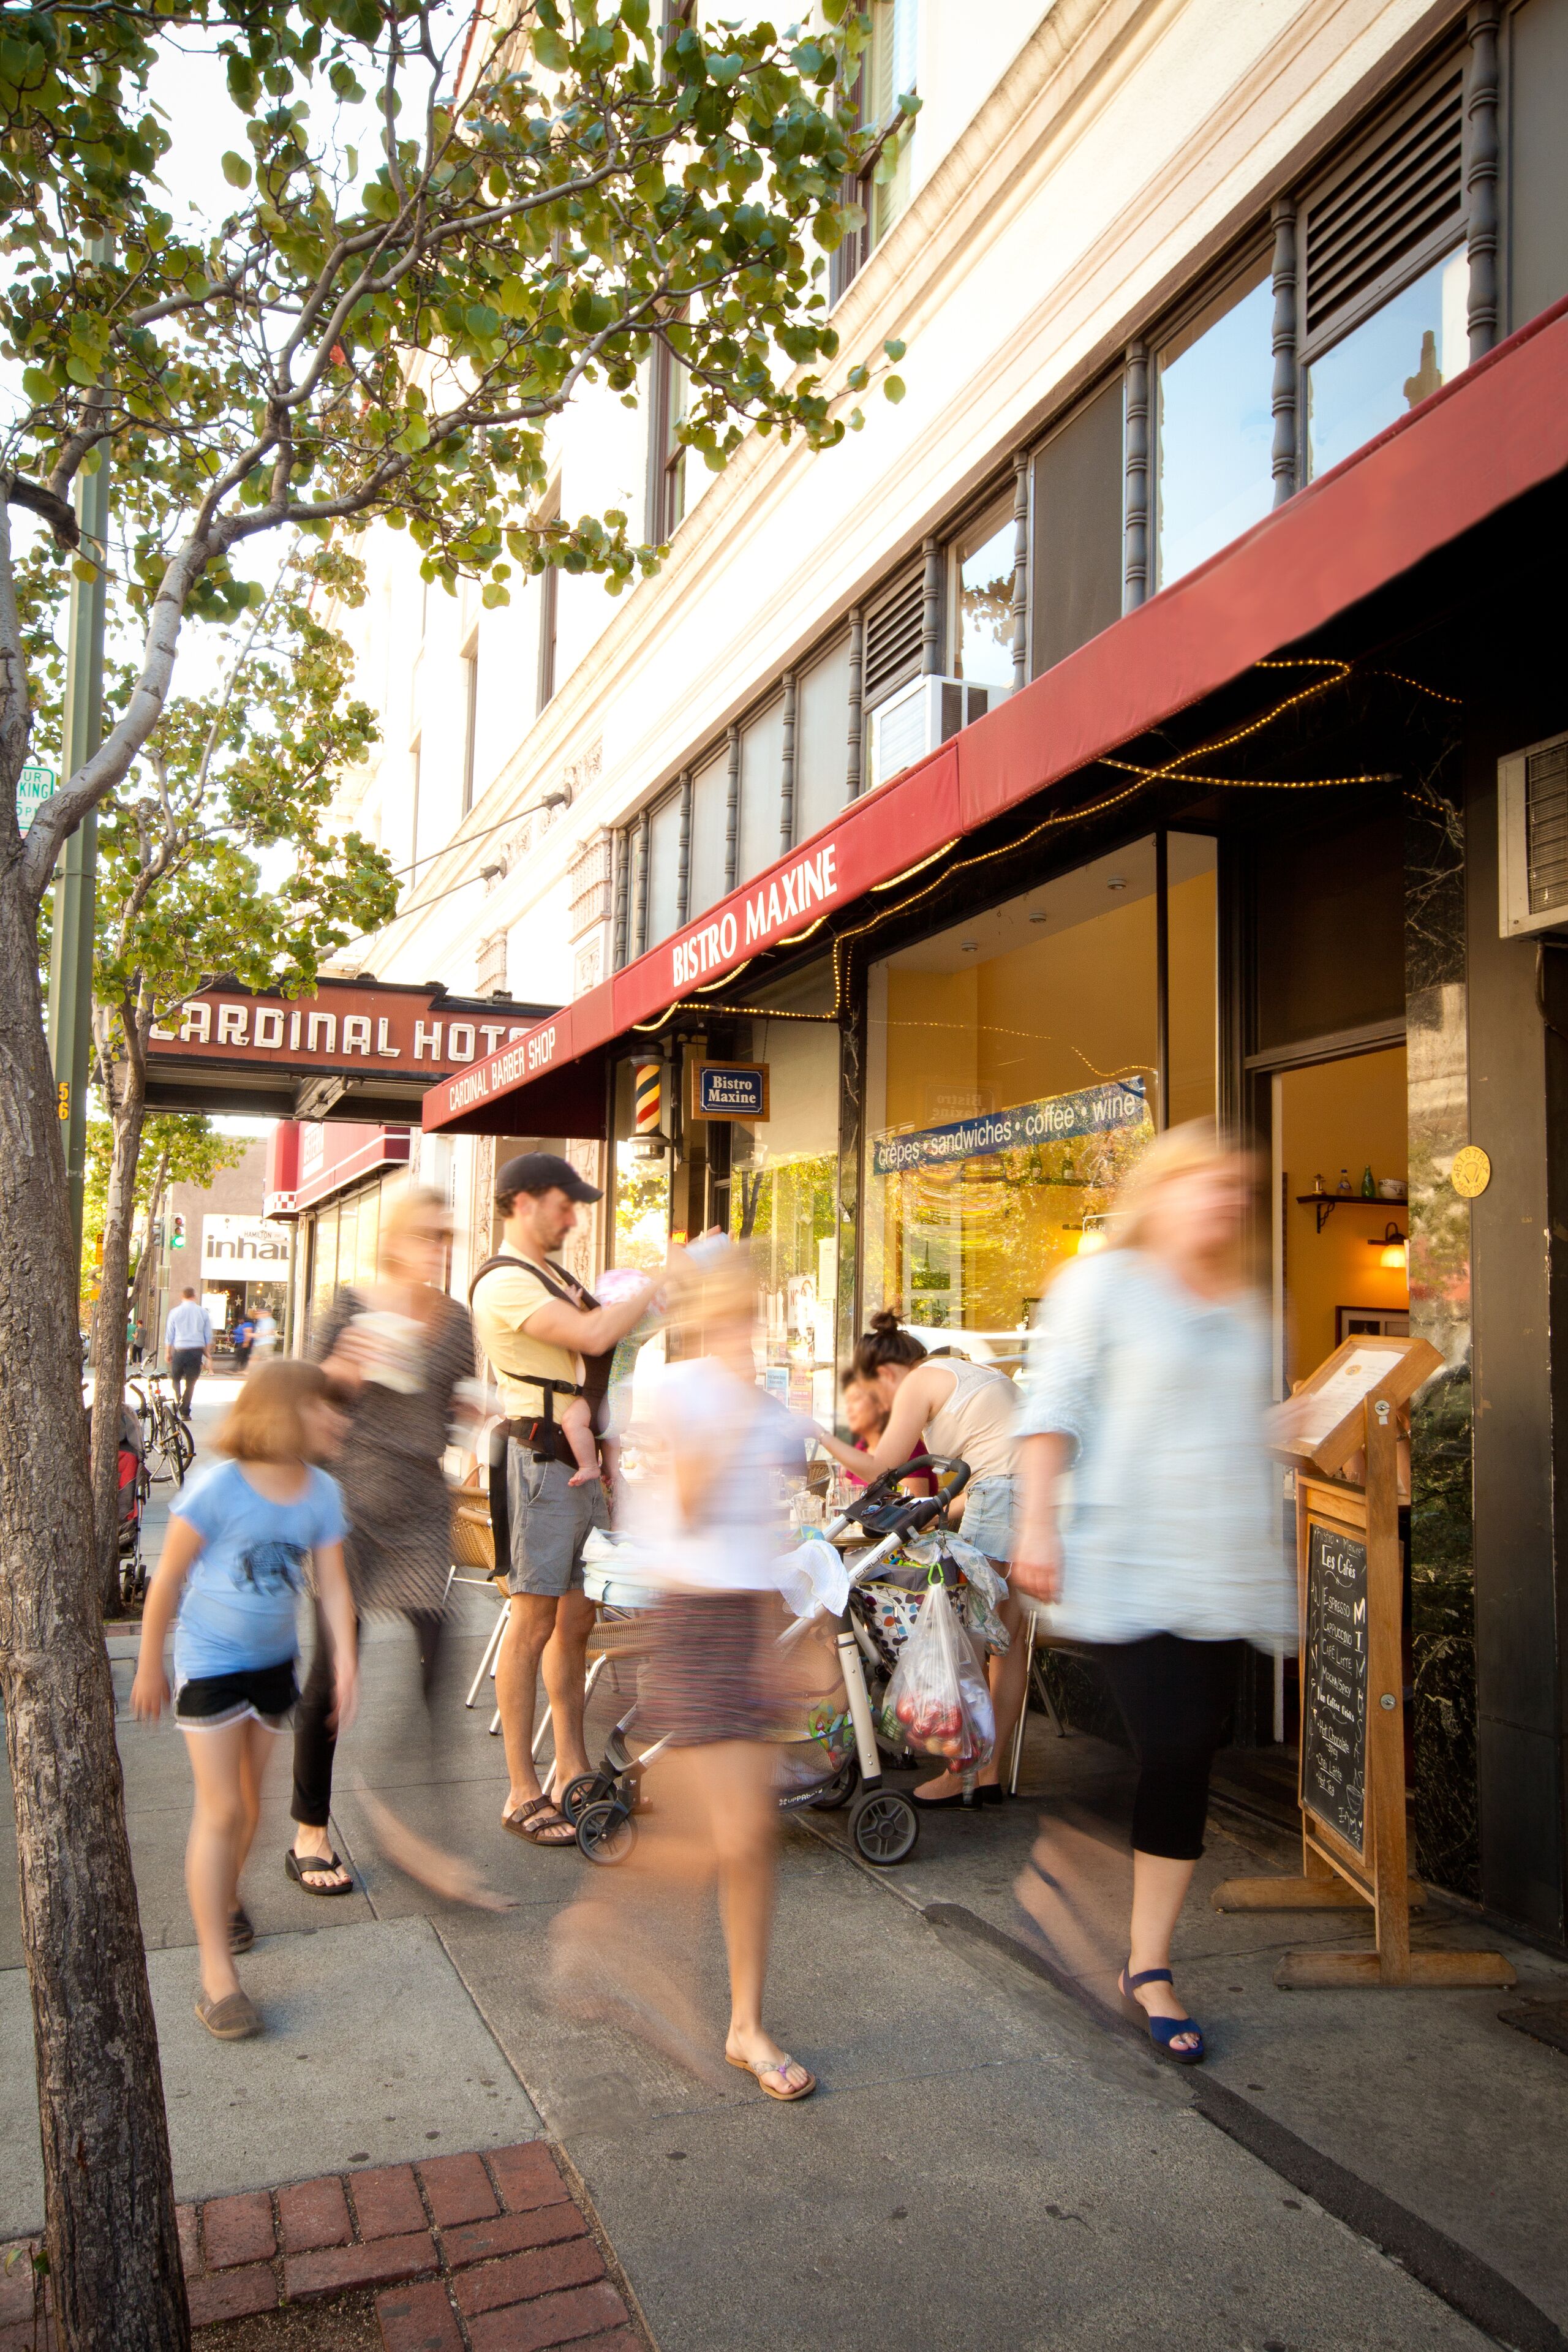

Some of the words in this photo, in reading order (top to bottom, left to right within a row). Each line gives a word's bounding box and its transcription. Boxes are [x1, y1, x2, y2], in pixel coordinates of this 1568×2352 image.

[19, 782, 48, 799] KING
[23, 772, 42, 782] UR
[672, 912, 737, 987] BISTRO
[745, 843, 838, 946] MAXINE
[413, 1020, 532, 1063] HOT
[450, 1068, 489, 1112] CARDINAL
[491, 1046, 525, 1091] BARBER
[528, 1026, 556, 1070] SHOP
[712, 1075, 753, 1090] Bistro
[707, 1088, 756, 1104] Maxine
[878, 1140, 921, 1167] crêpes
[930, 1118, 1012, 1156] sandwiches
[1025, 1106, 1075, 1136] coffee
[1093, 1092, 1136, 1122] wine
[855, 1549, 888, 1580] CRUZ
[1322, 1544, 1335, 1570] Les
